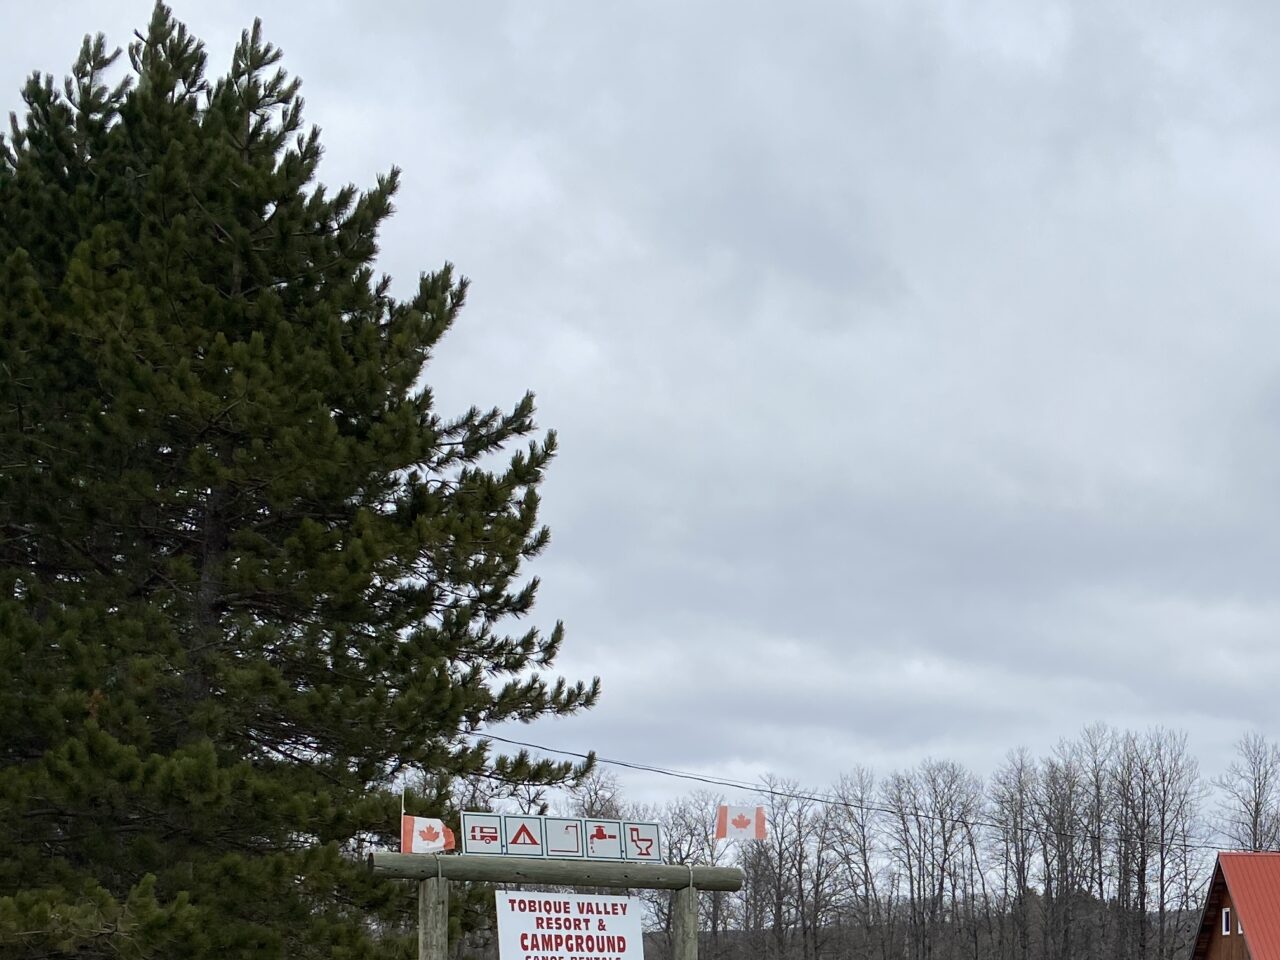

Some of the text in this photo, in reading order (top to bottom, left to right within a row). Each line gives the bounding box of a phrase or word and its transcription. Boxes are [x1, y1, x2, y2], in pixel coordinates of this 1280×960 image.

[508, 898, 628, 916] TOBIQUE VALLEY
[535, 916, 607, 932] RESORT &
[520, 932, 627, 953] CAMPGROUND
